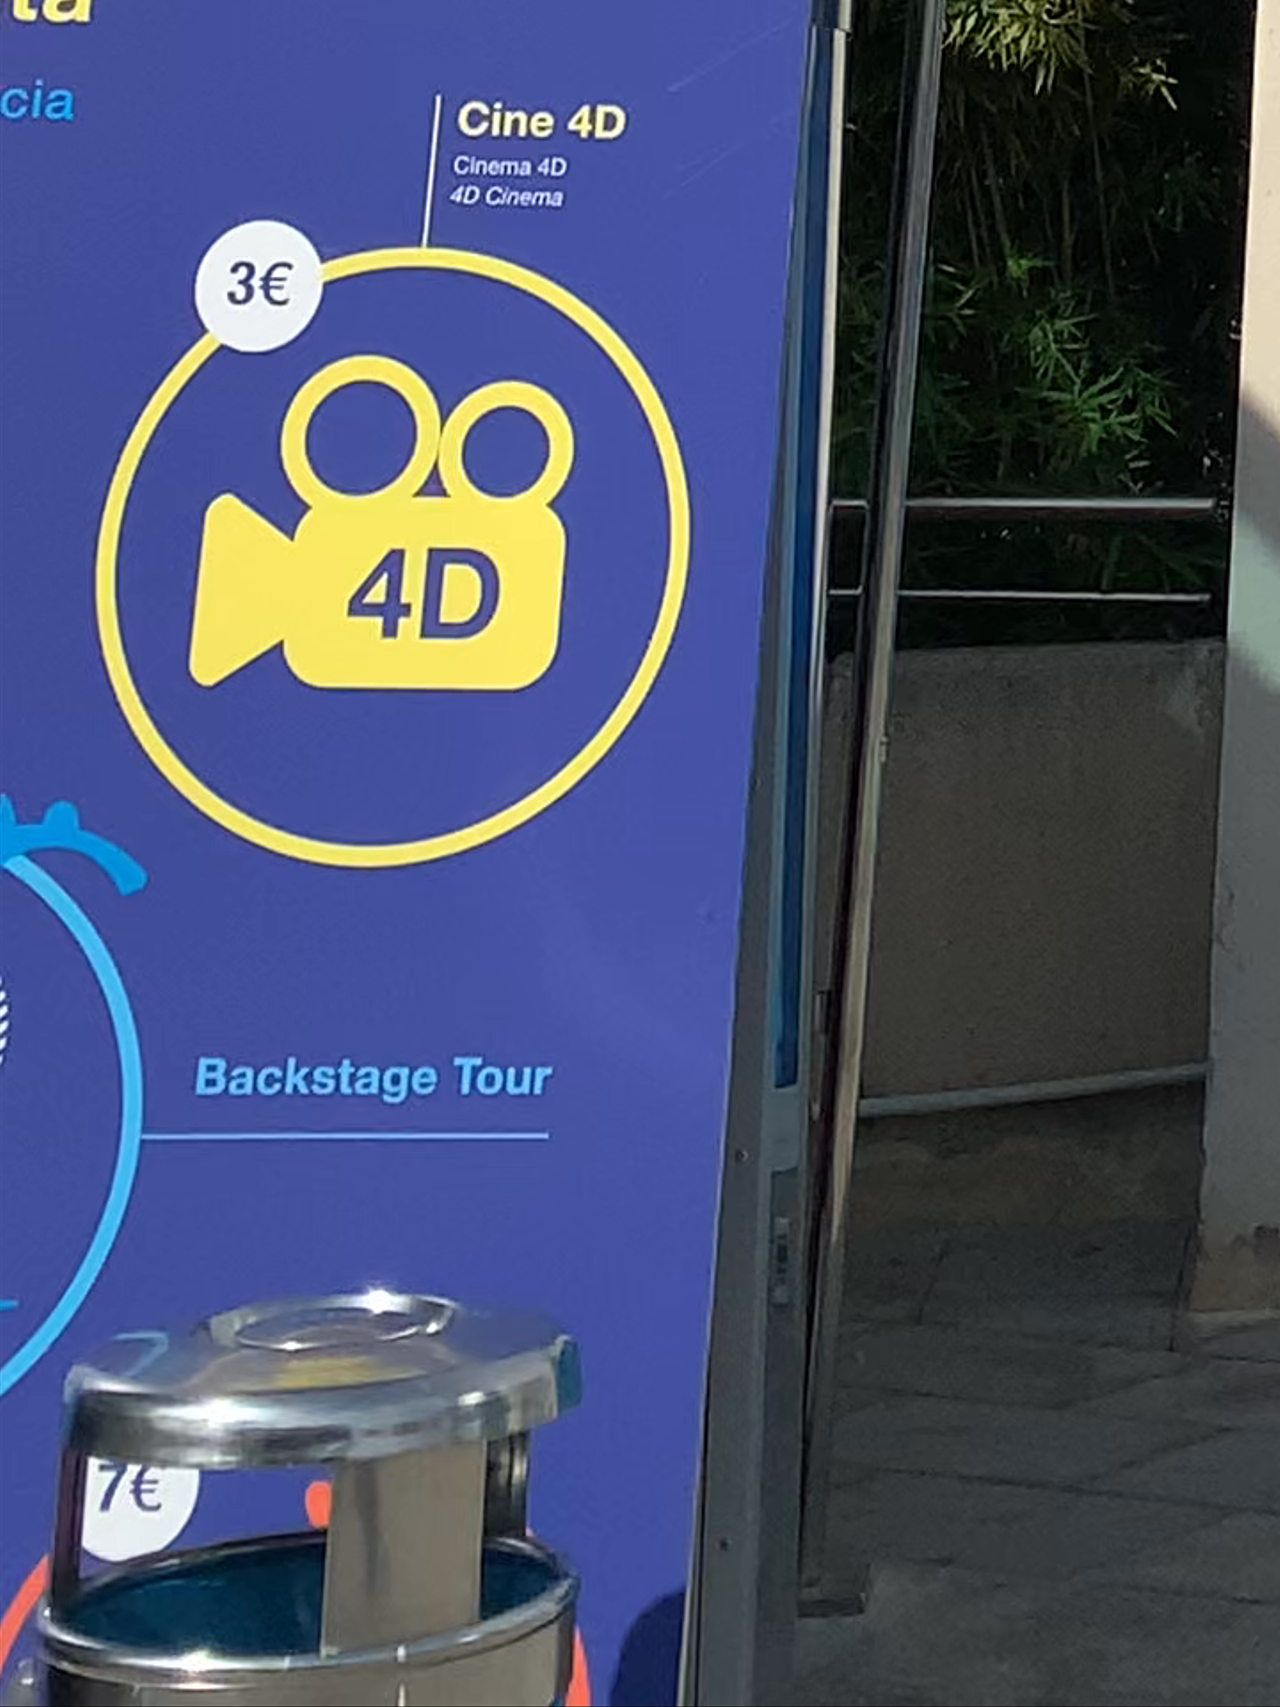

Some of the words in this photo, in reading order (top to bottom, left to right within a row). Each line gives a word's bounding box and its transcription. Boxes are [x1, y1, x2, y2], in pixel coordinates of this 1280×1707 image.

[457, 100, 555, 139] Cine
[566, 103, 627, 140] 4D
[453, 154, 532, 176] Cinema
[537, 156, 568, 178] 4D
[449, 184, 481, 205] 4D
[485, 185, 565, 207] Cinema
[225, 260, 294, 307] 3€
[346, 546, 502, 642] 4D
[194, 1055, 439, 1104] Backstage
[453, 1056, 553, 1097] Tour
